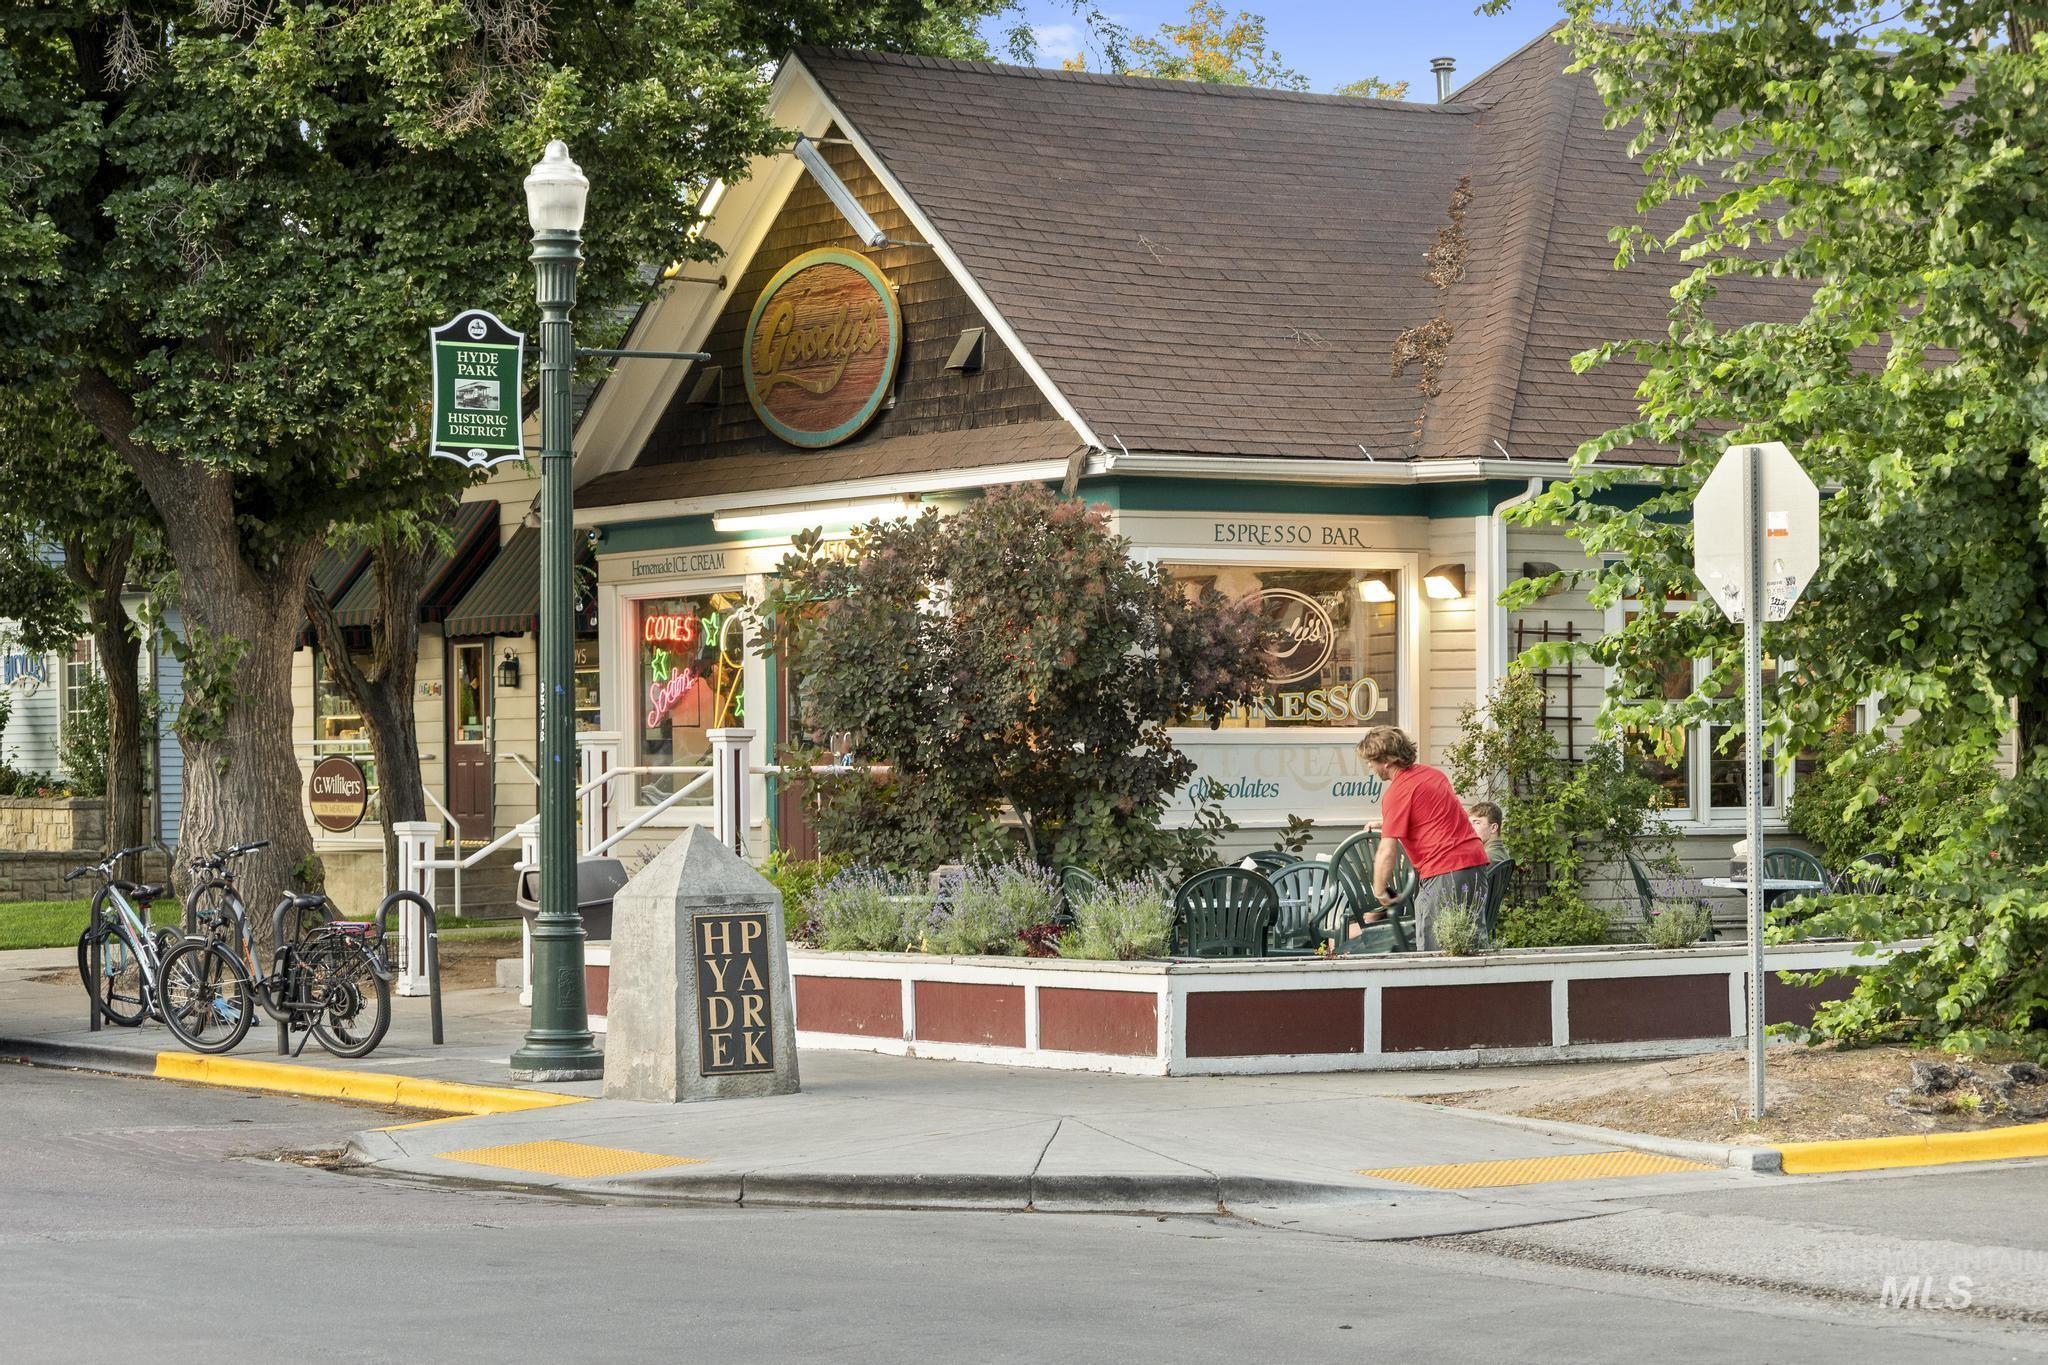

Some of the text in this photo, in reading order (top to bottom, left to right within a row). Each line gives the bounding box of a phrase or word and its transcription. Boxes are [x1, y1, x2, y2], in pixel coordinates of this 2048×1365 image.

[456, 351, 499, 365] HYDE
[753, 299, 882, 400] Goody's
[457, 363, 499, 377] PARK
[447, 412, 508, 426] HISTORIC
[449, 424, 507, 438] DISTRICT
[1214, 523, 1374, 549] ESPRESSO BAR
[631, 552, 726, 577] Homemade ICE CREAM
[645, 615, 693, 642] CONES
[647, 667, 699, 728] Sodas
[1332, 774, 1383, 804] candy
[702, 920, 768, 1067] HYDE PARK
